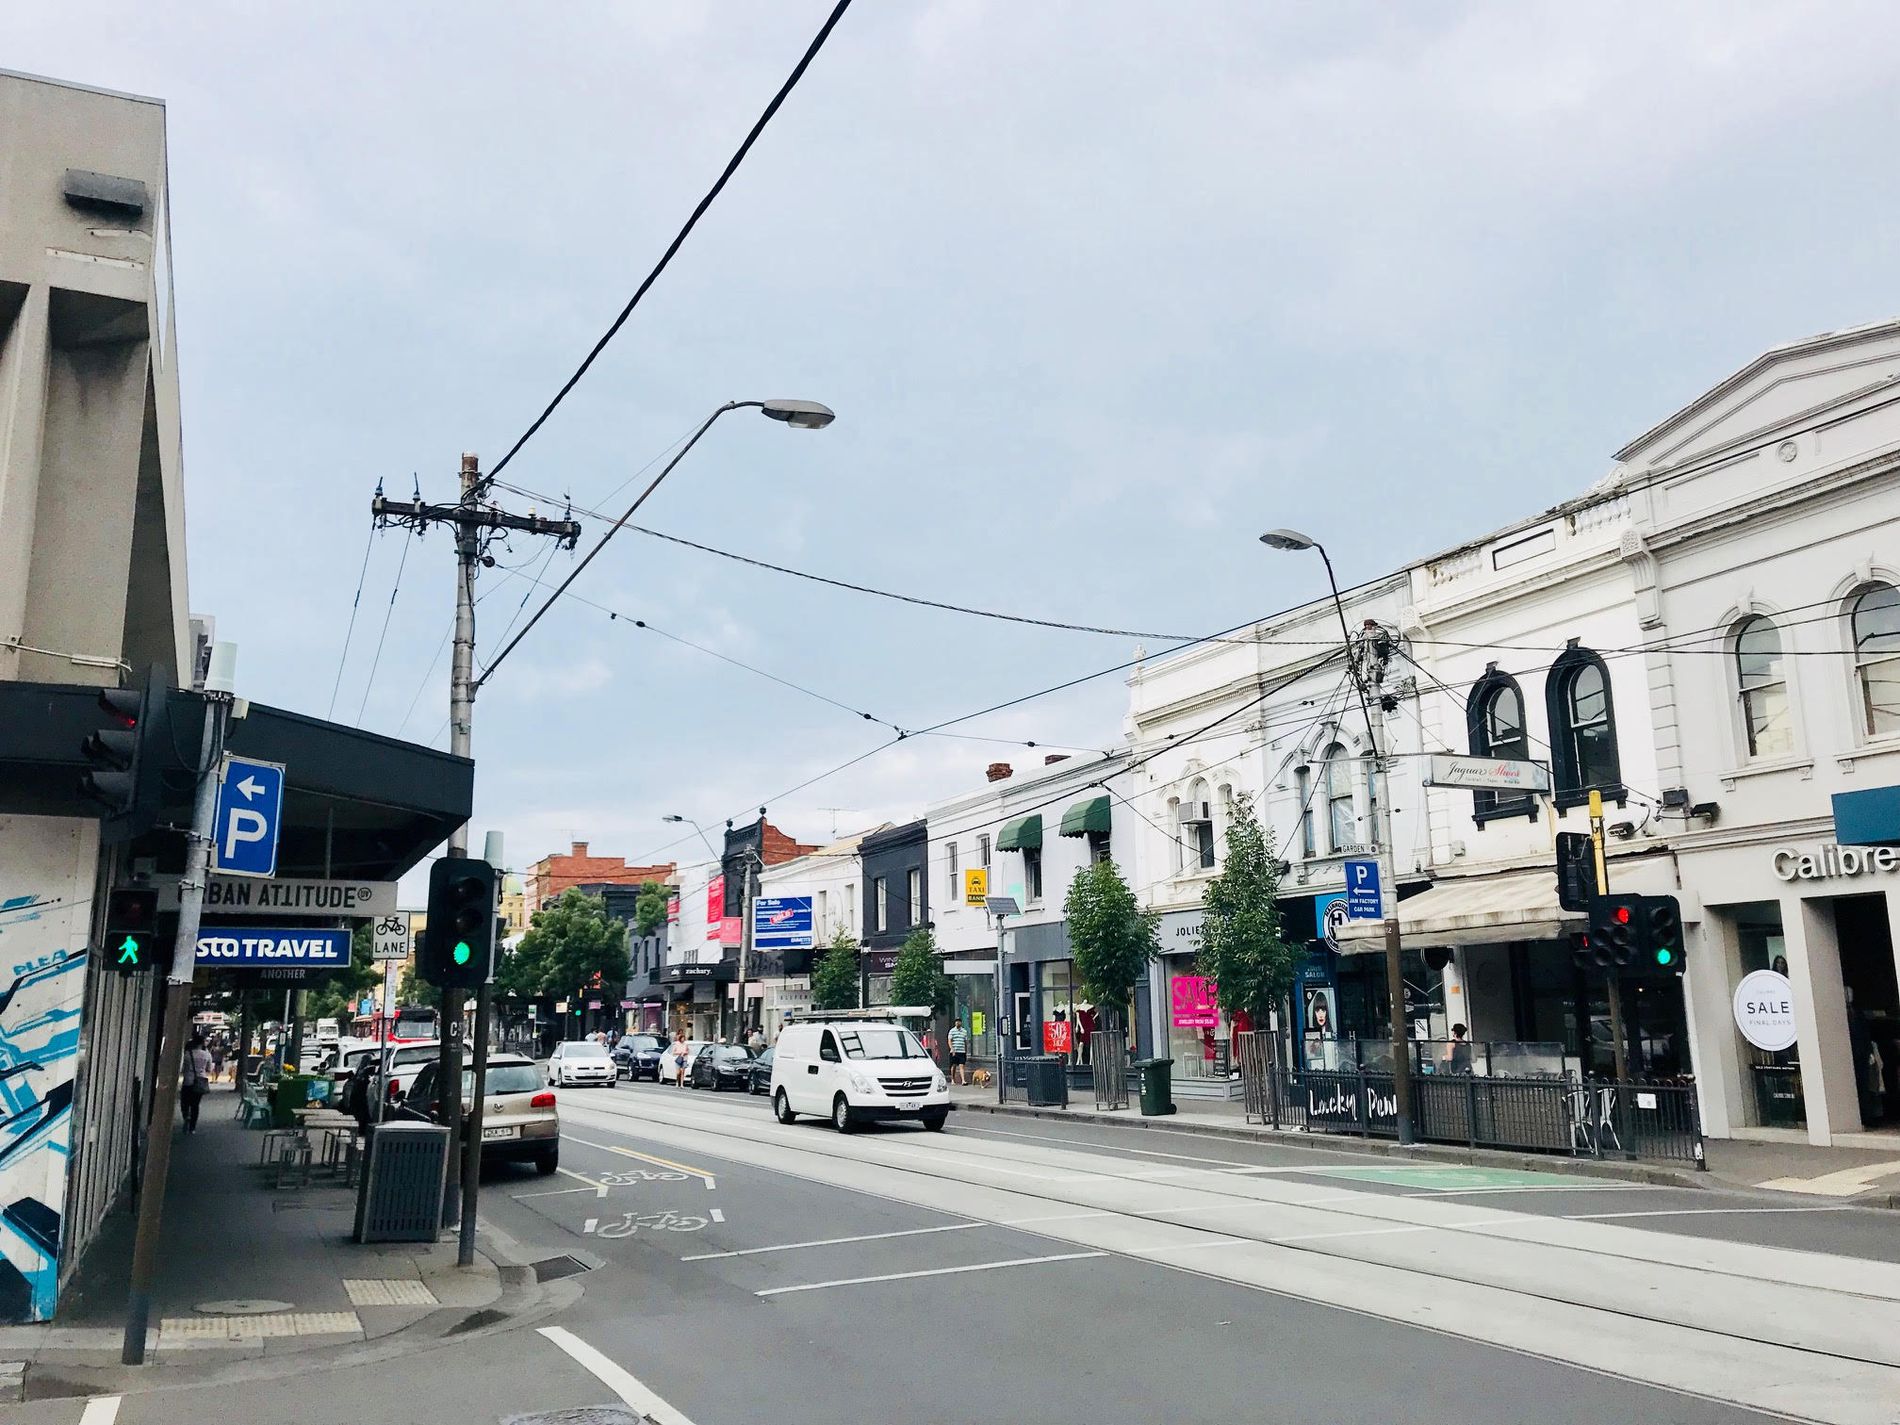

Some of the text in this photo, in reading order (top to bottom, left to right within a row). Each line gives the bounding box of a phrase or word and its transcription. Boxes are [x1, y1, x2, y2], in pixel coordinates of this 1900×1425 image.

[224, 807, 268, 859] P
[1772, 844, 1899, 881] Calibre
[1356, 865, 1368, 885] P
[178, 882, 251, 906] BAN
[241, 938, 338, 958] TRAVEL
[374, 941, 406, 953] LANE
[260, 967, 306, 979] ANOTHER
[1746, 1001, 1790, 1014] SALE
